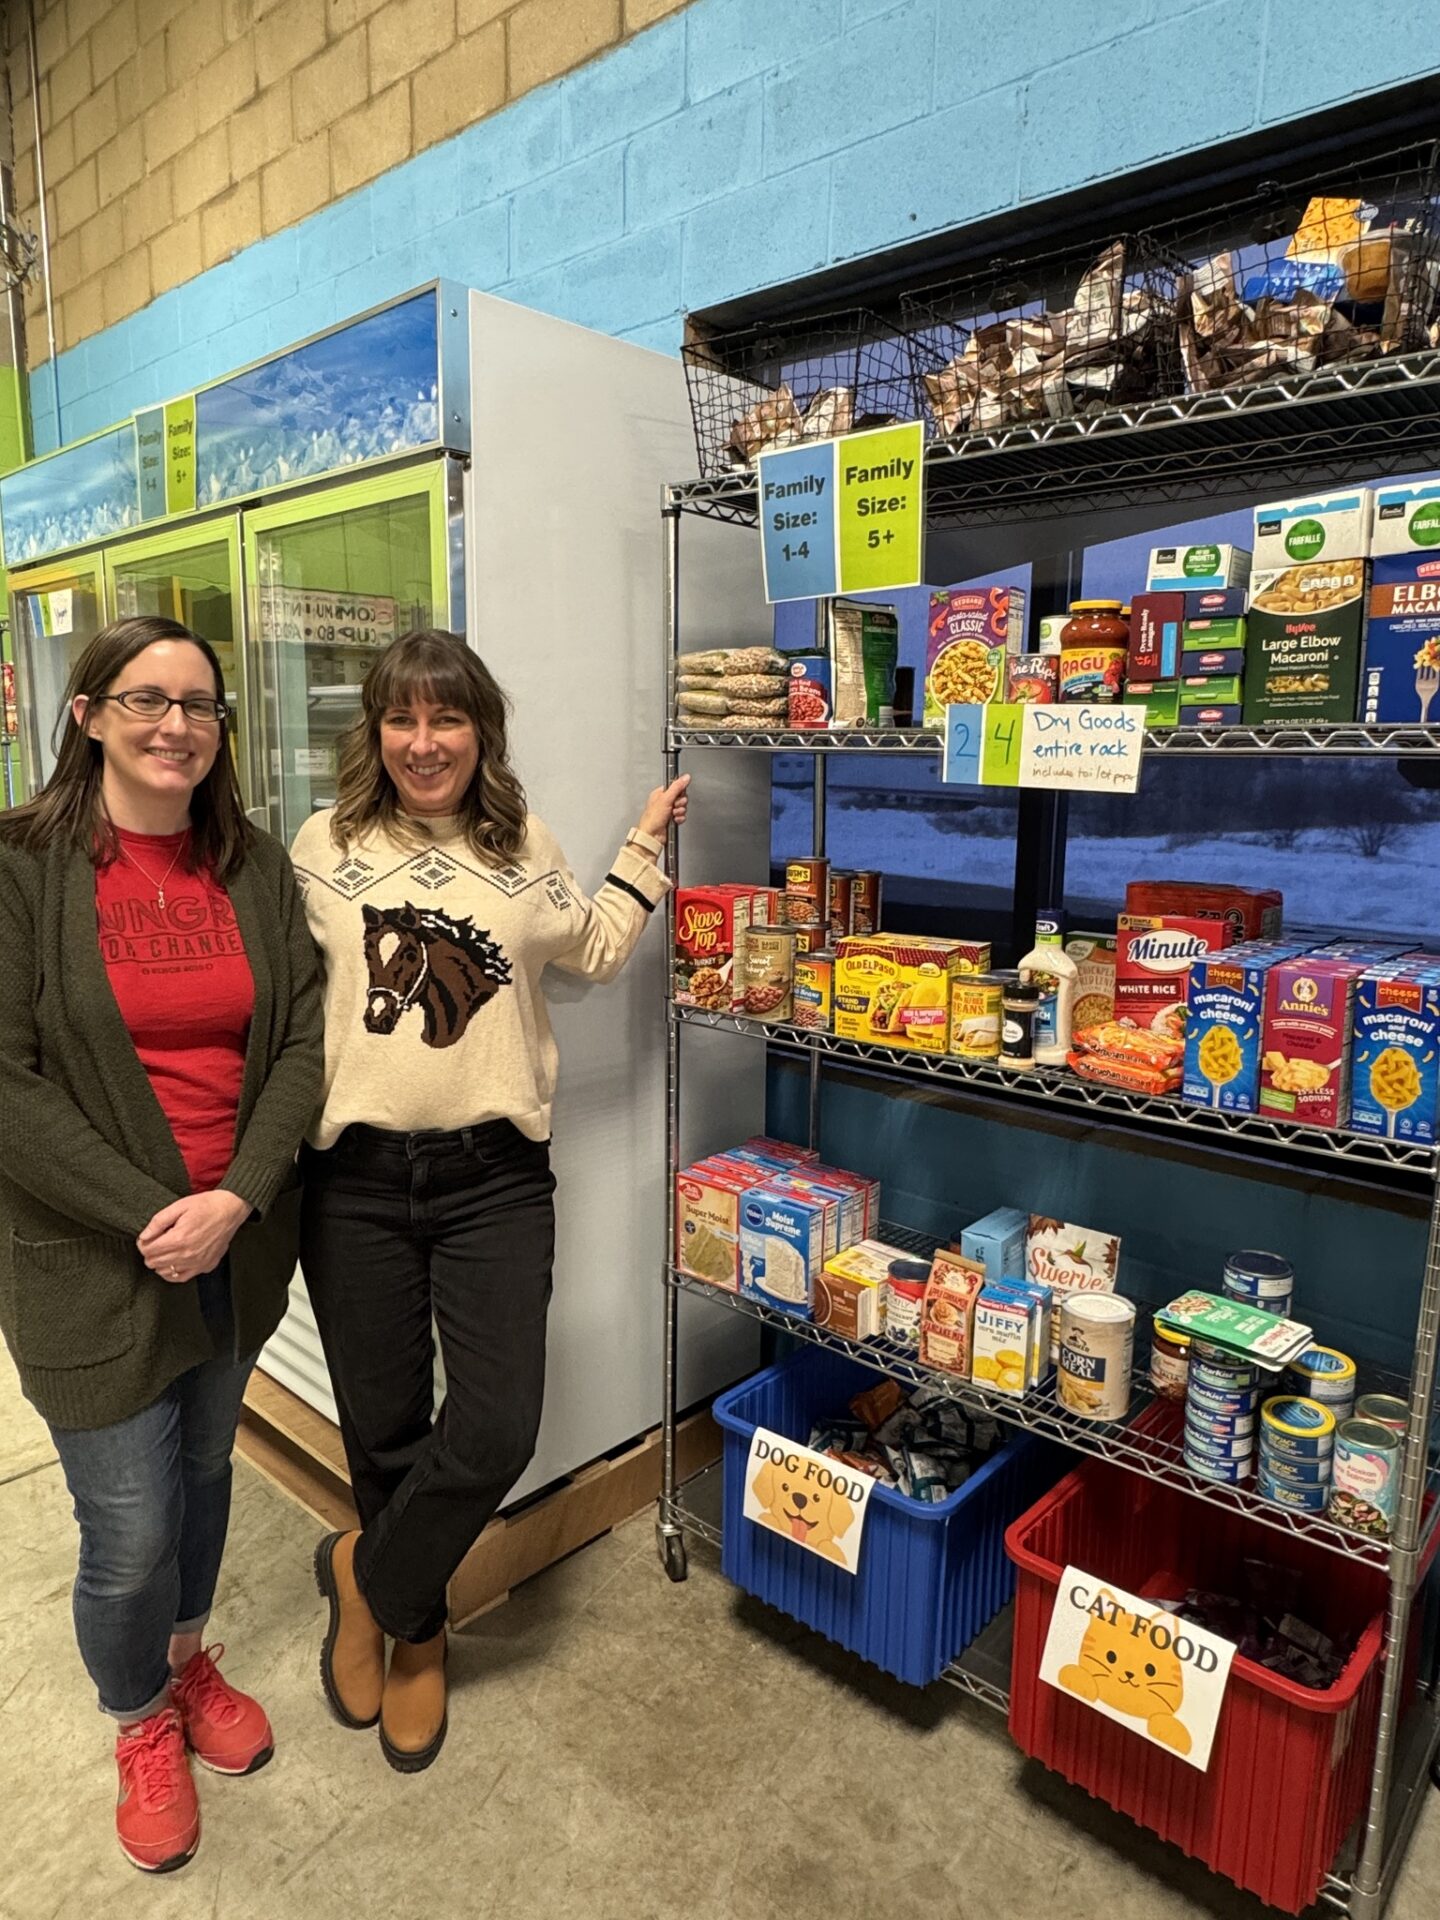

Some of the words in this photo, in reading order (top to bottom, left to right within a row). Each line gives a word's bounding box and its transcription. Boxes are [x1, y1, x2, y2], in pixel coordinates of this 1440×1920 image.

[167, 419, 193, 439] Family
[172, 446, 191, 461] Size:
[176, 469, 187, 484] 5+
[845, 457, 915, 486] Family
[764, 475, 826, 501] Family
[857, 495, 907, 517] Size:
[773, 511, 818, 532] Size:
[867, 529, 895, 549] 5+
[1288, 533, 1321, 547] FARFALLE
[782, 540, 810, 562] 1-4
[949, 620, 985, 635] CLASSIC
[1262, 639, 1298, 653] Large
[1300, 635, 1342, 648] Elbow
[1270, 649, 1329, 665] Macaroni
[1030, 657, 1057, 680] Ripe
[1033, 711, 1071, 733] Dry
[1078, 709, 1136, 731] Goods
[954, 723, 978, 758] 2
[994, 719, 1016, 765] 4
[1033, 741, 1083, 759] entire
[1090, 740, 1129, 757] rack
[679, 905, 725, 941] Stove
[150, 933, 241, 958] CHANGE
[693, 930, 718, 952] Top
[1128, 937, 1207, 961] Minute
[1208, 968, 1243, 979] cheese
[840, 984, 850, 993] 10
[1119, 985, 1150, 994] WHITE
[1152, 985, 1177, 994] RICE
[1379, 987, 1420, 998] cheese
[1193, 993, 1256, 1013] macaroni
[1280, 999, 1329, 1017] Annie's
[1199, 1007, 1245, 1025] cheese
[1362, 1013, 1436, 1034] macaroni
[1370, 1028, 1424, 1047] cheese
[1298, 1094, 1331, 1102] SODIUM
[1315, 1088, 1335, 1096] LESS
[685, 1204, 707, 1217] Super
[708, 1211, 729, 1225] Moist
[772, 1210, 795, 1225] Moist
[765, 1216, 802, 1237] Supreme
[1031, 1246, 1106, 1291] Swerve
[977, 1311, 1024, 1334] JIFFY
[1061, 1358, 1096, 1379] MEAL
[1062, 1347, 1096, 1370] CORN
[1199, 1363, 1235, 1378] StarKist
[754, 1439, 800, 1474] DOG
[802, 1461, 866, 1503] FOOD
[1069, 1585, 1126, 1628] CAT
[1130, 1613, 1219, 1673] FOOD
